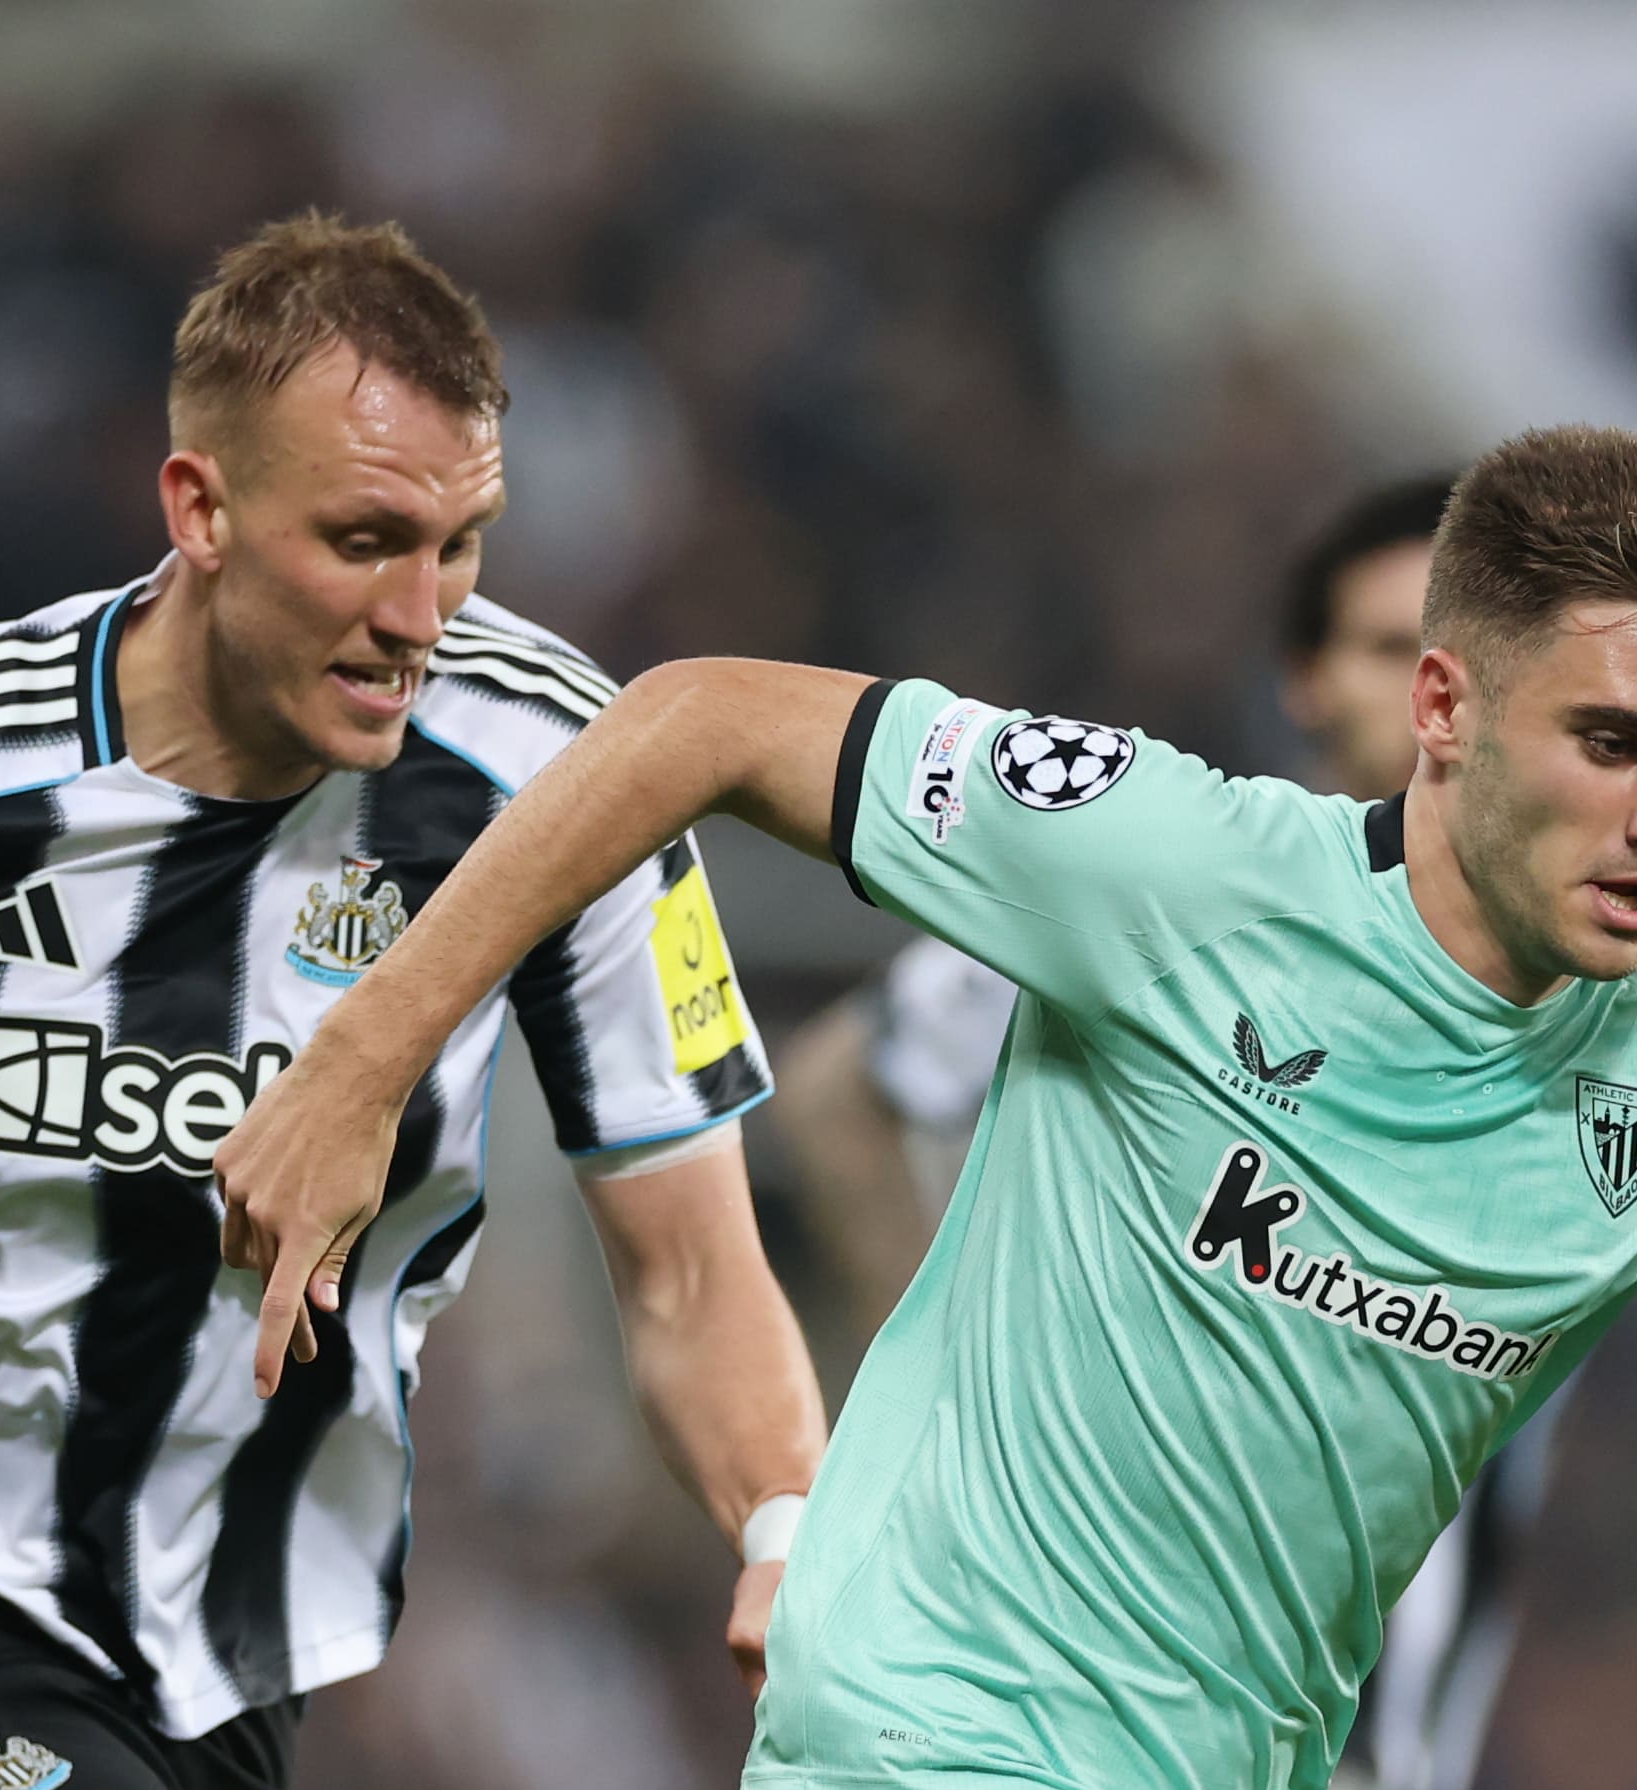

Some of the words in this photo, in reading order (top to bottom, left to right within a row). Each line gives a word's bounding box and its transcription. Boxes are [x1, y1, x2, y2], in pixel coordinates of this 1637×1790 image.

[1218, 1068, 1301, 1115] CASTORE
[1584, 1084, 1634, 1102] ATHLETIC
[878, 1728, 933, 1746] AERTEK
